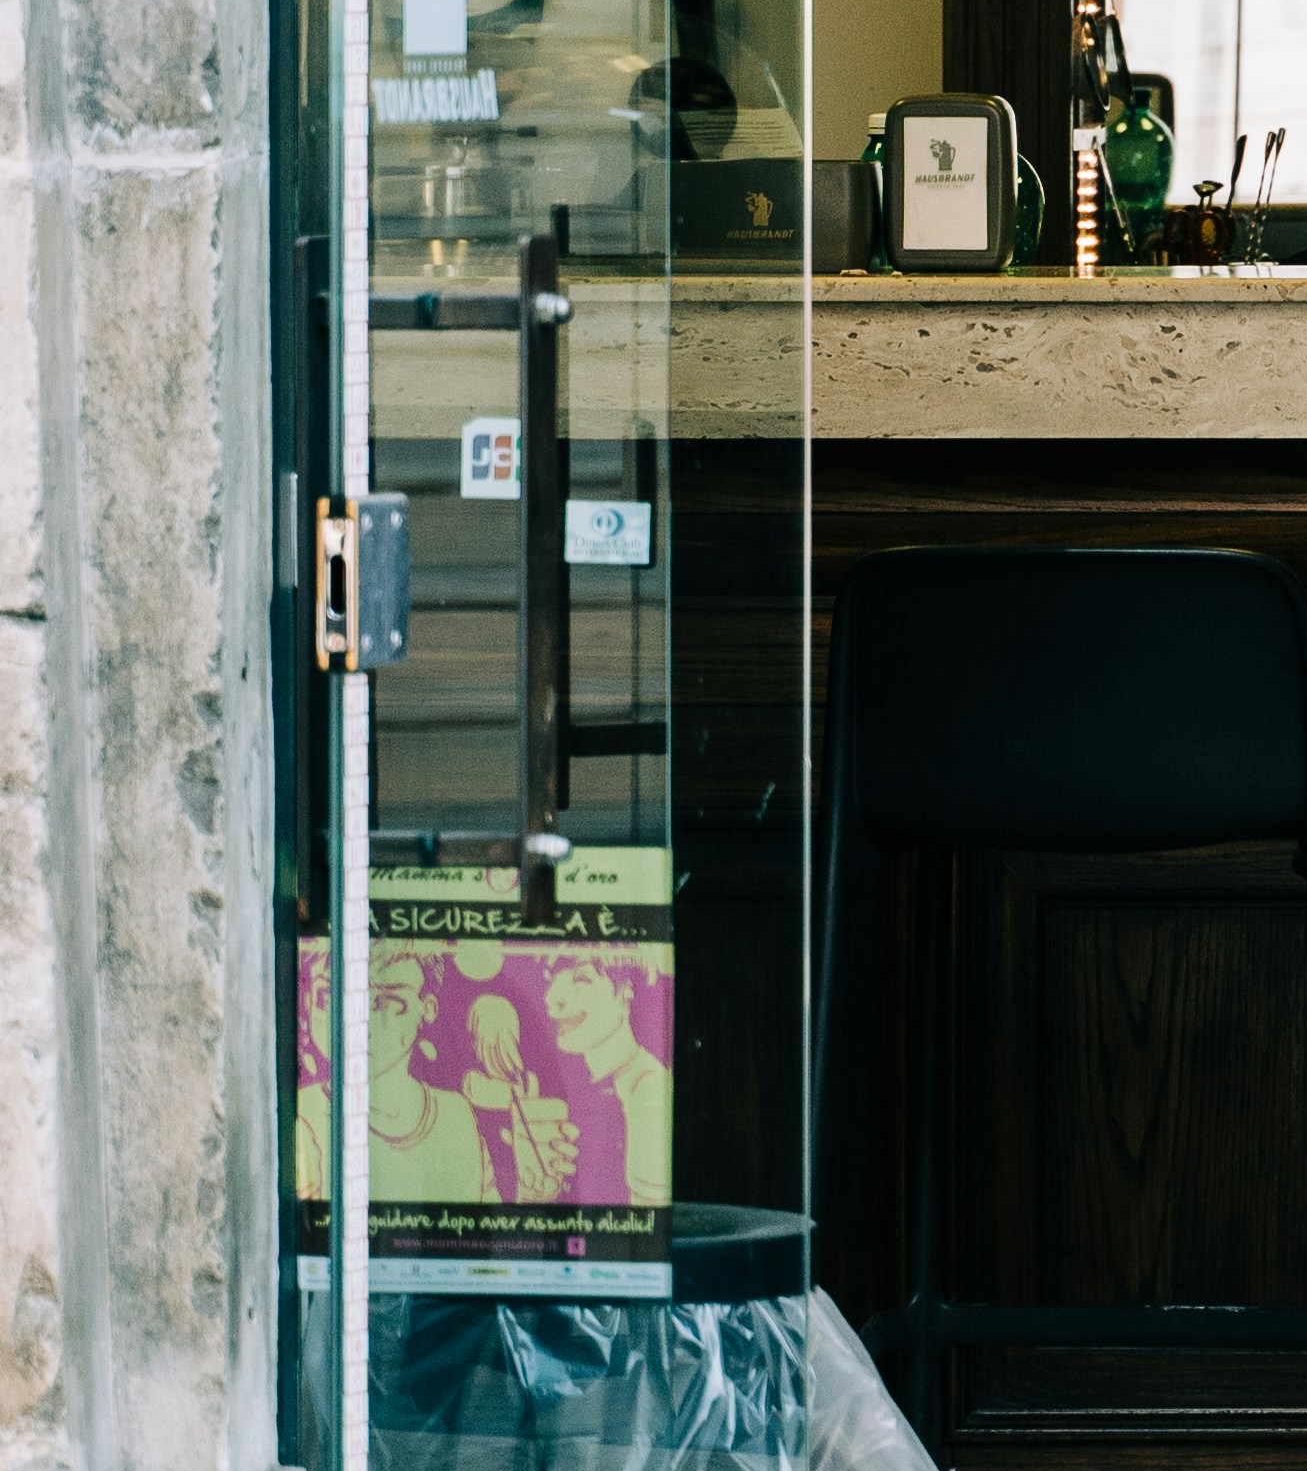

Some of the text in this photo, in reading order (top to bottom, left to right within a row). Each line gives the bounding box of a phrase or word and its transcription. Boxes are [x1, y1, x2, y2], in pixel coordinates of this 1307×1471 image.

[915, 172, 976, 185] HAUSBRANDT
[726, 227, 795, 240] HAUSBRANDT
[471, 433, 522, 481] JC
[564, 863, 618, 884] d'oro
[368, 1211, 435, 1236] guidare
[438, 1209, 475, 1236] dopo
[480, 1214, 521, 1232] aver
[524, 1210, 593, 1232] assunto
